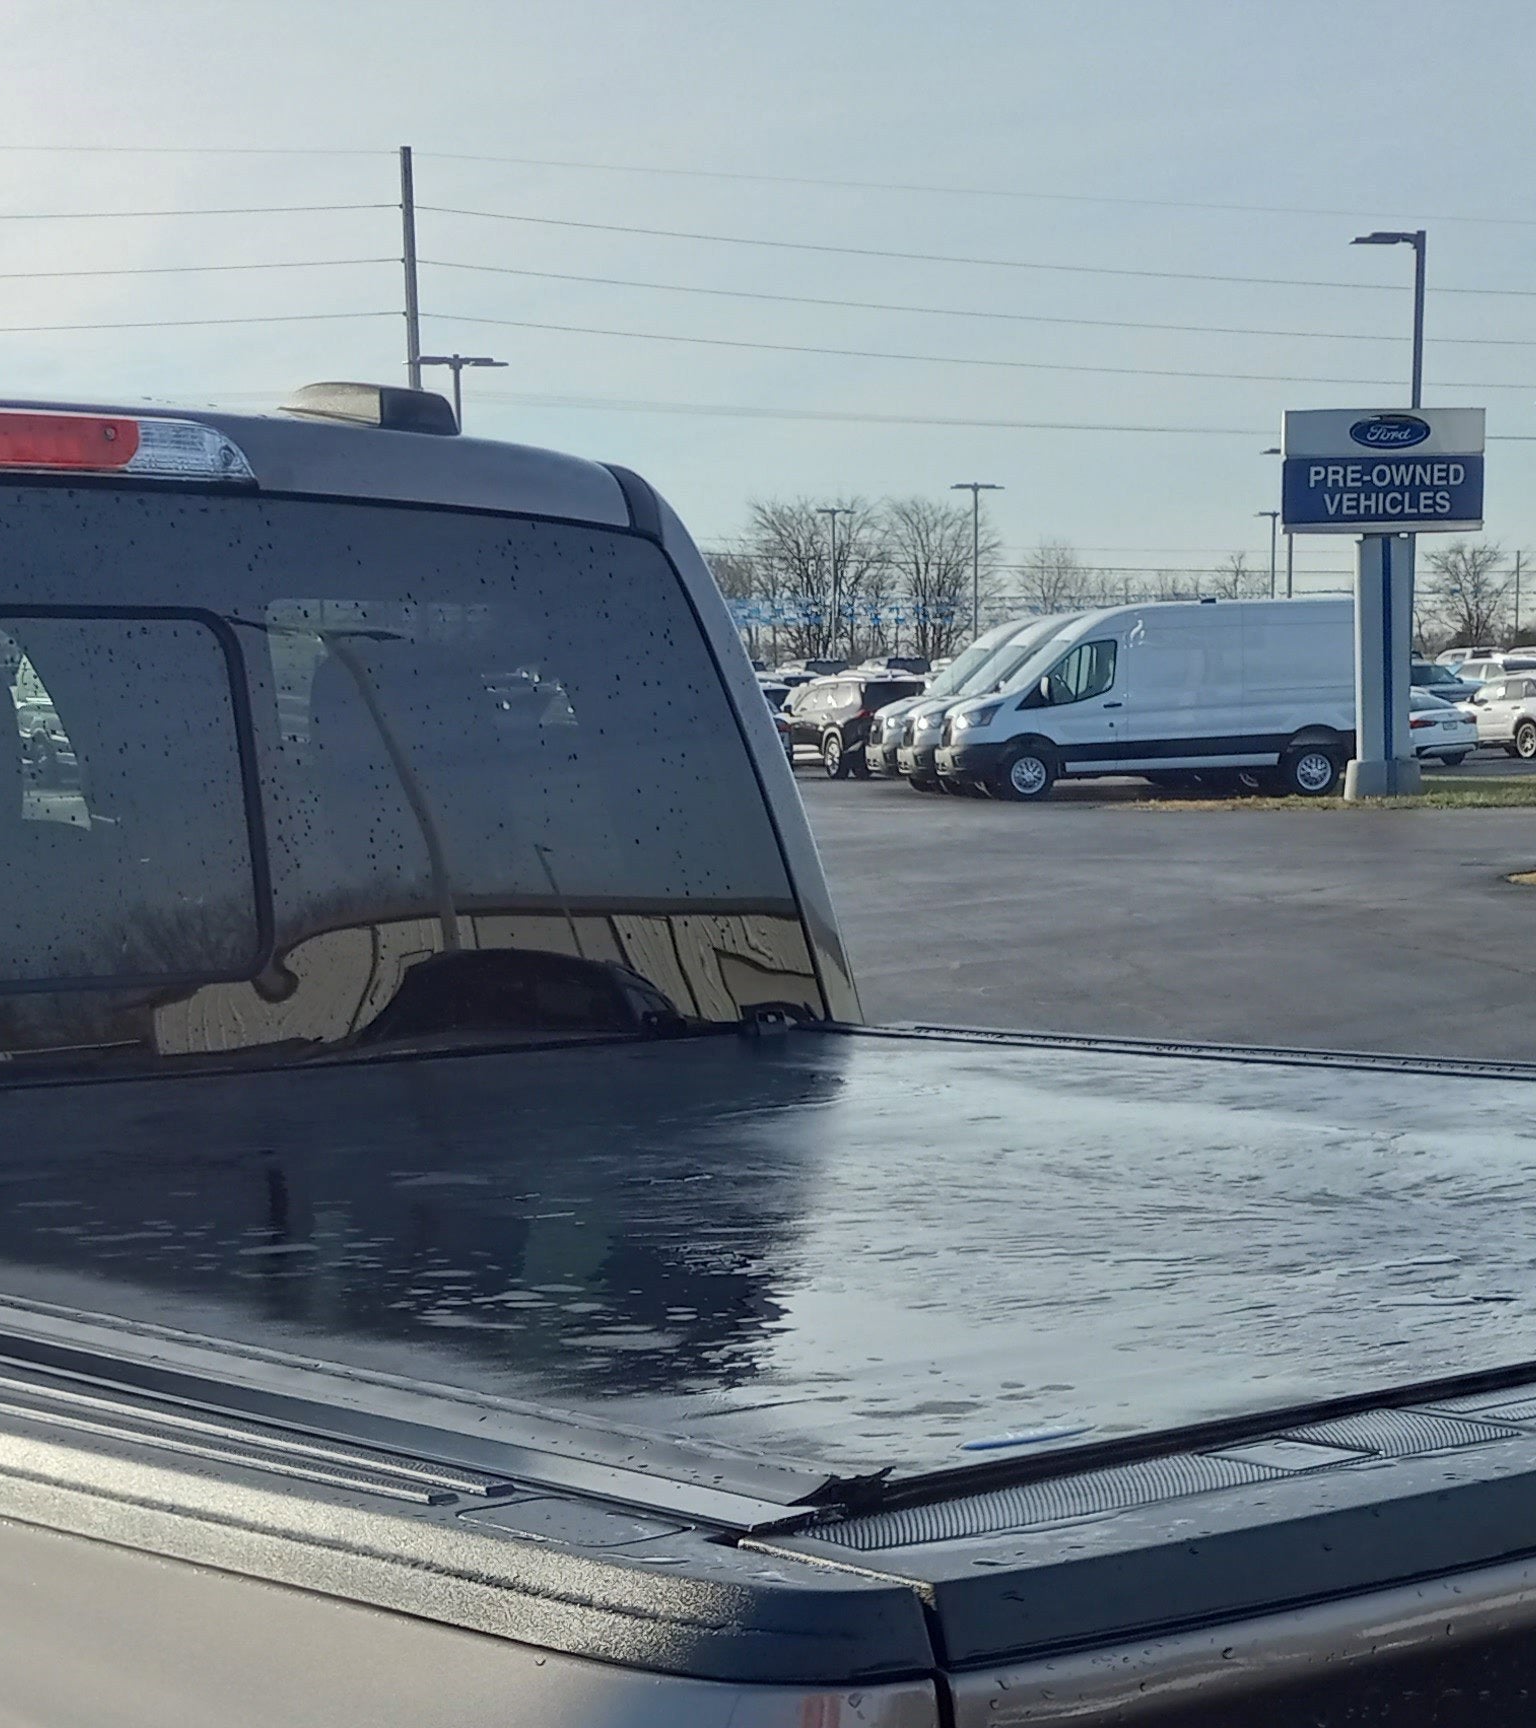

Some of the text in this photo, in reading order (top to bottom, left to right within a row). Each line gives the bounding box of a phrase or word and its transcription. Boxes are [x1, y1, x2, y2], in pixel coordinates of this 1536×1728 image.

[1366, 424, 1412, 442] Ford
[1309, 463, 1465, 488] PRE-OWNED
[1324, 490, 1451, 516] VEHICLES
